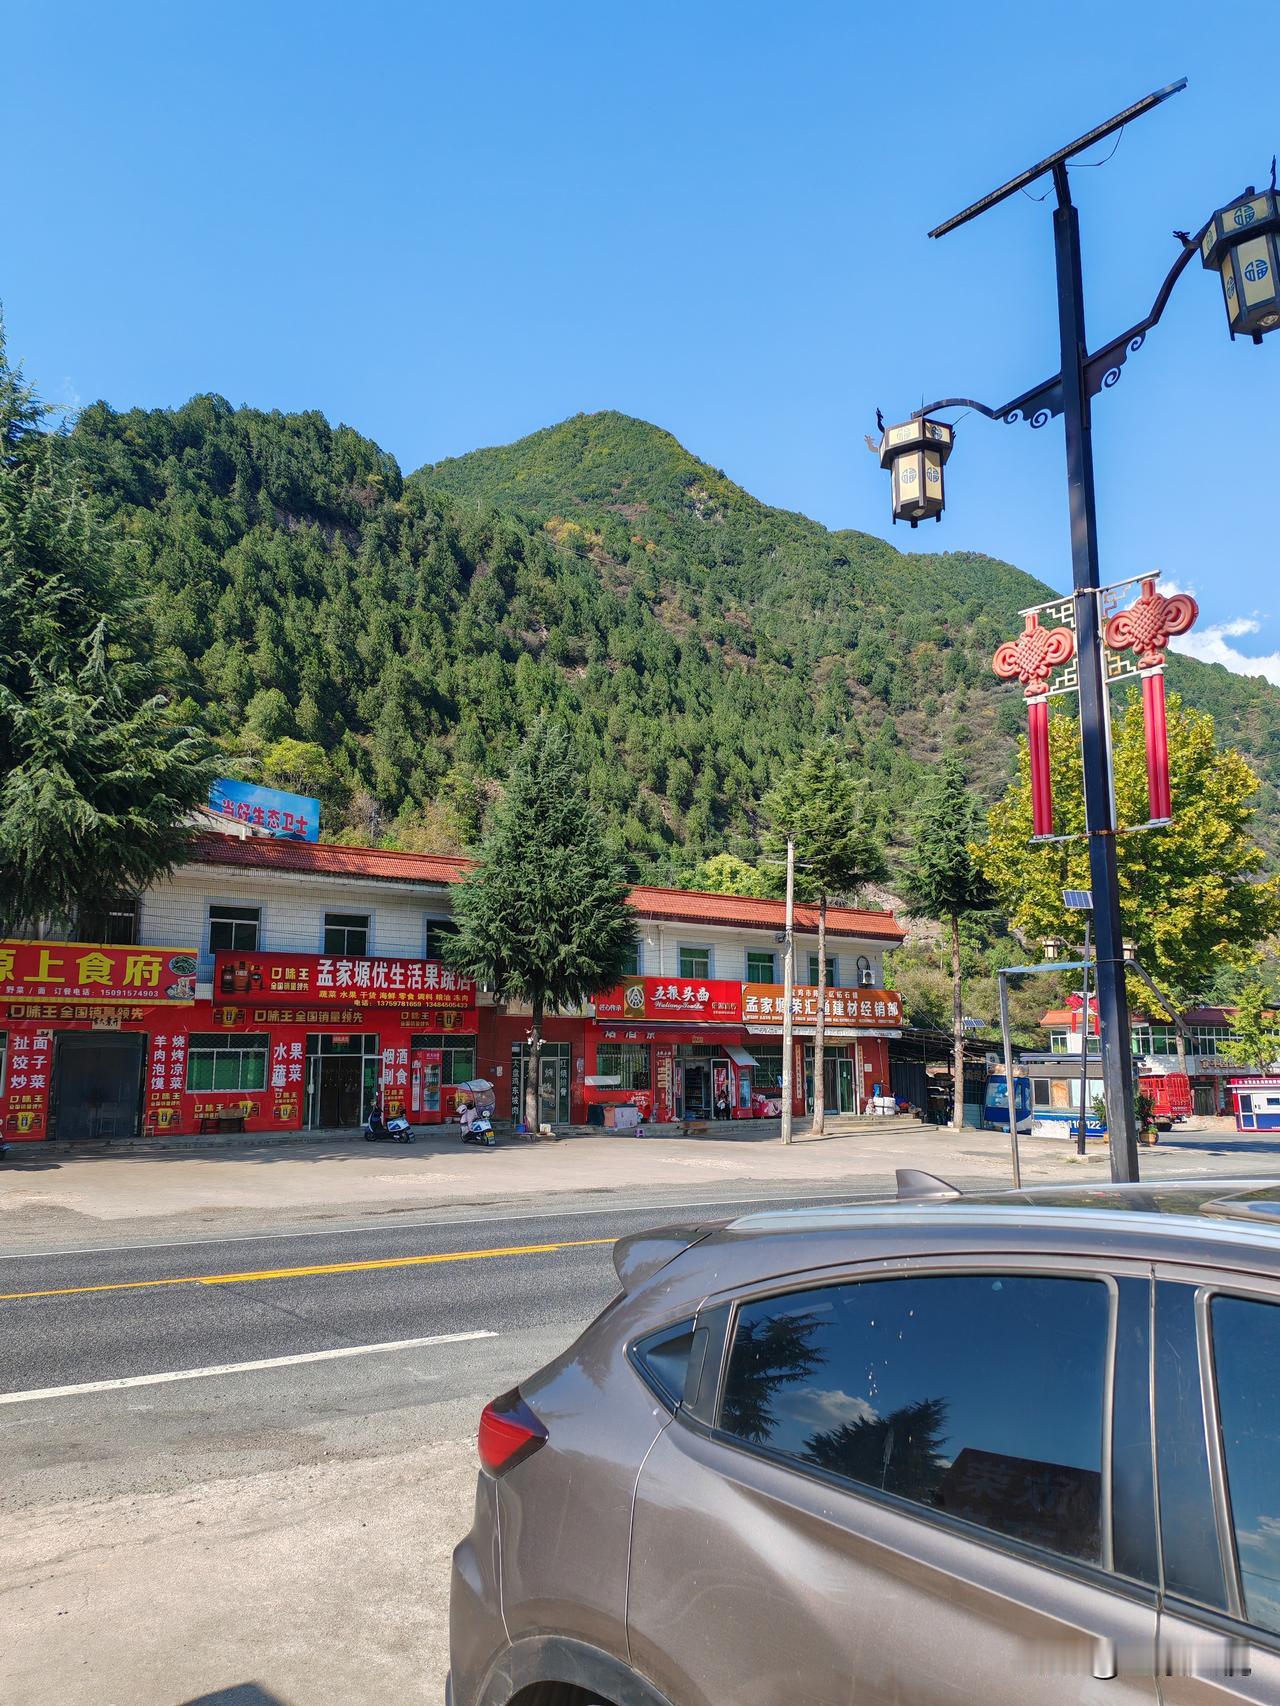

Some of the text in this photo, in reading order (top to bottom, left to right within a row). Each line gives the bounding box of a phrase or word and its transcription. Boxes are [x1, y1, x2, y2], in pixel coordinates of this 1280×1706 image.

[222, 799, 309, 836] 当好生态卫士
[271, 967, 309, 981] 口味王
[340, 991, 357, 999] 水果
[14, 1035, 48, 1051] 扯面
[274, 1042, 303, 1060] 水果
[12, 1055, 47, 1070] 饺子
[10, 1074, 46, 1089] 炒菜
